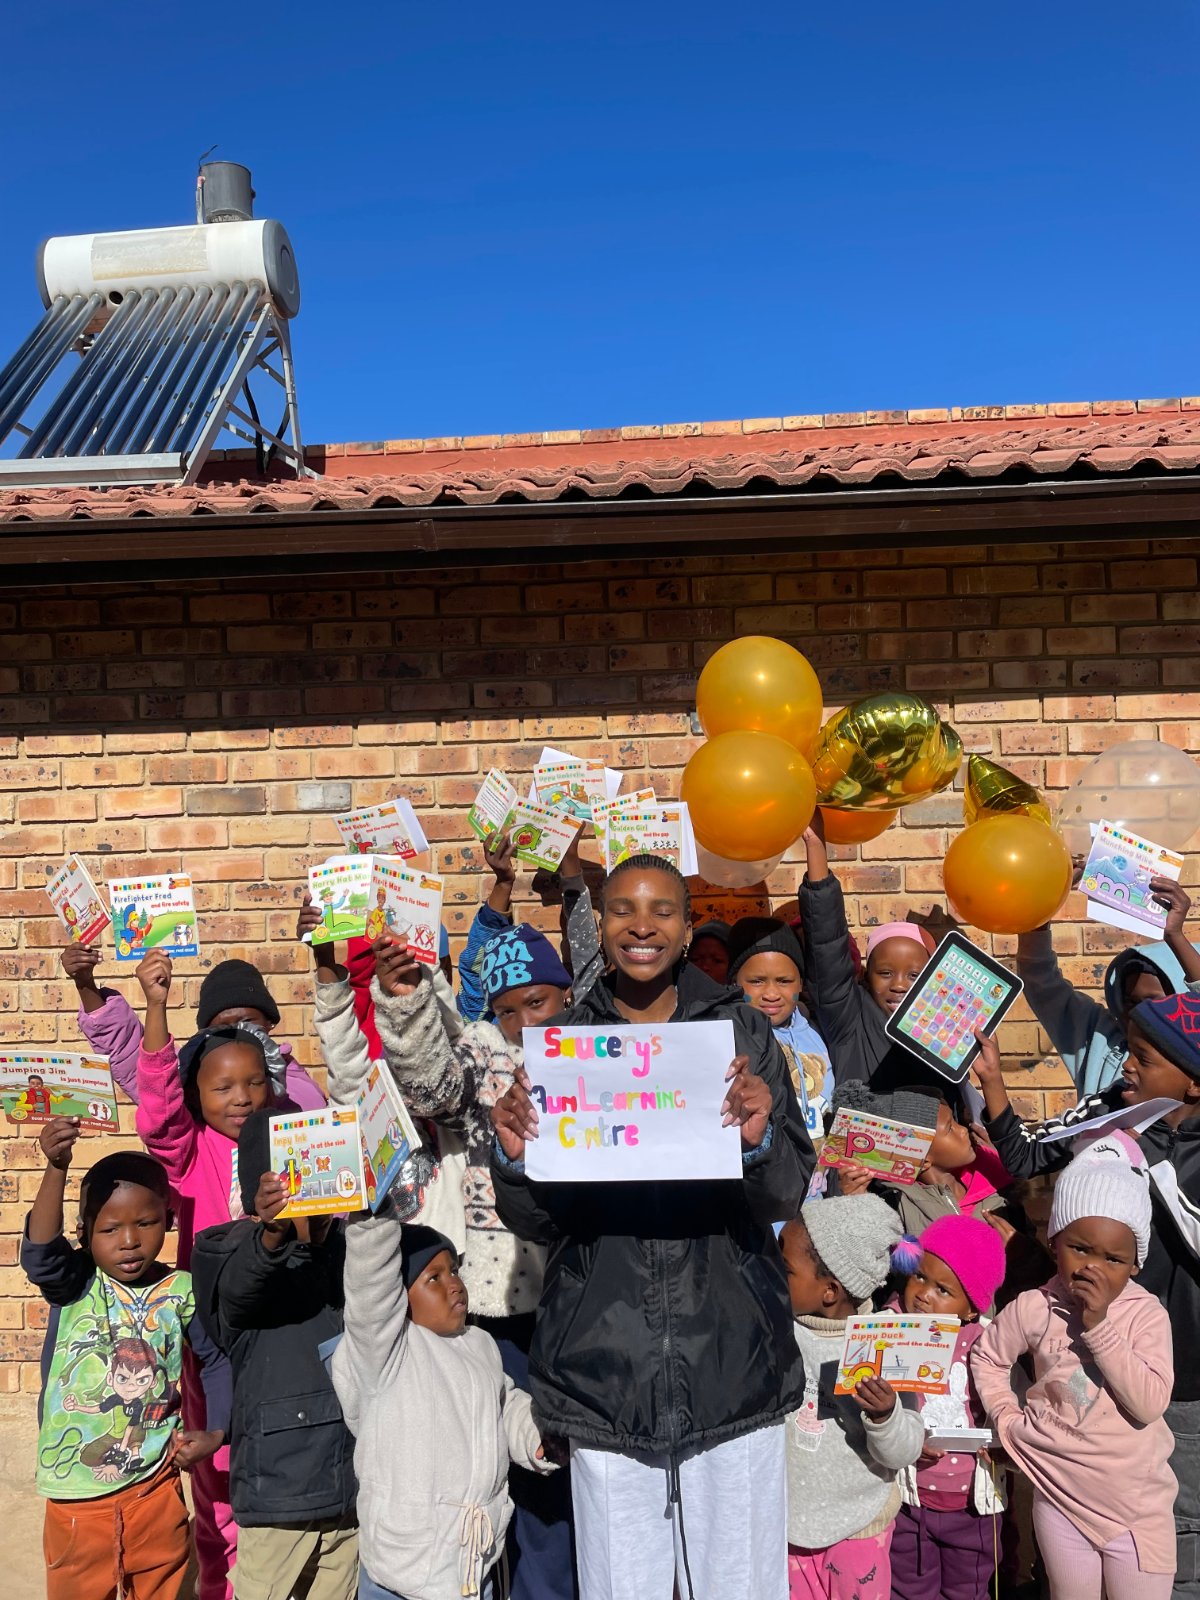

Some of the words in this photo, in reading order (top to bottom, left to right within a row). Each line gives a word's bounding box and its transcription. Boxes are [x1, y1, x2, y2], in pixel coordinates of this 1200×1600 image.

[114, 894, 153, 903] Firefighter
[544, 1027, 662, 1077] Saucery's
[2, 1067, 46, 1075] Jumping
[48, 1067, 67, 1075] Jim
[82, 1079, 108, 1087] jumping
[864, 1128, 891, 1140] Puppy
[851, 1333, 878, 1341] Dippy
